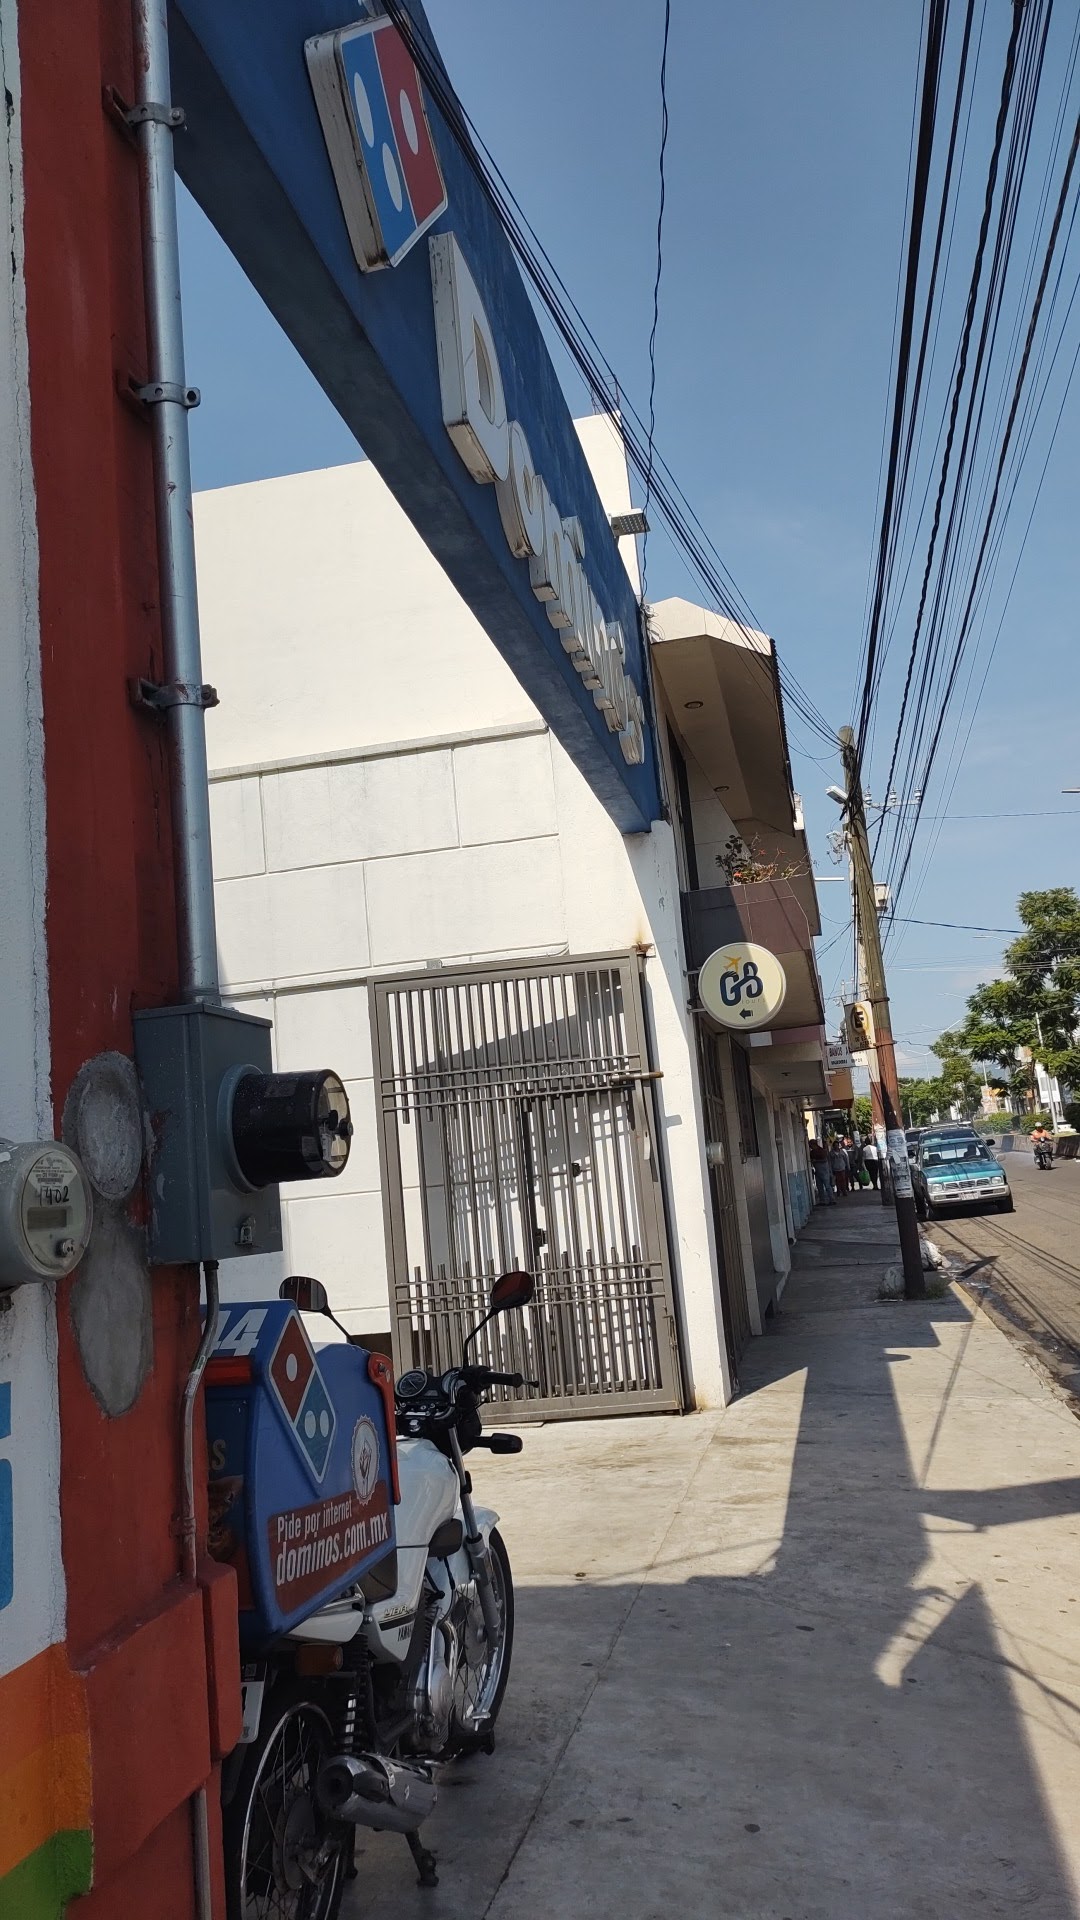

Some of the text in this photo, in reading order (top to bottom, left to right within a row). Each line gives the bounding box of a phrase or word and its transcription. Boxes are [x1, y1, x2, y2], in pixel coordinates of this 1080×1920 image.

[277, 1512, 389, 1586] dominos.com.mx
[278, 1496, 352, 1543] Pide por internet
